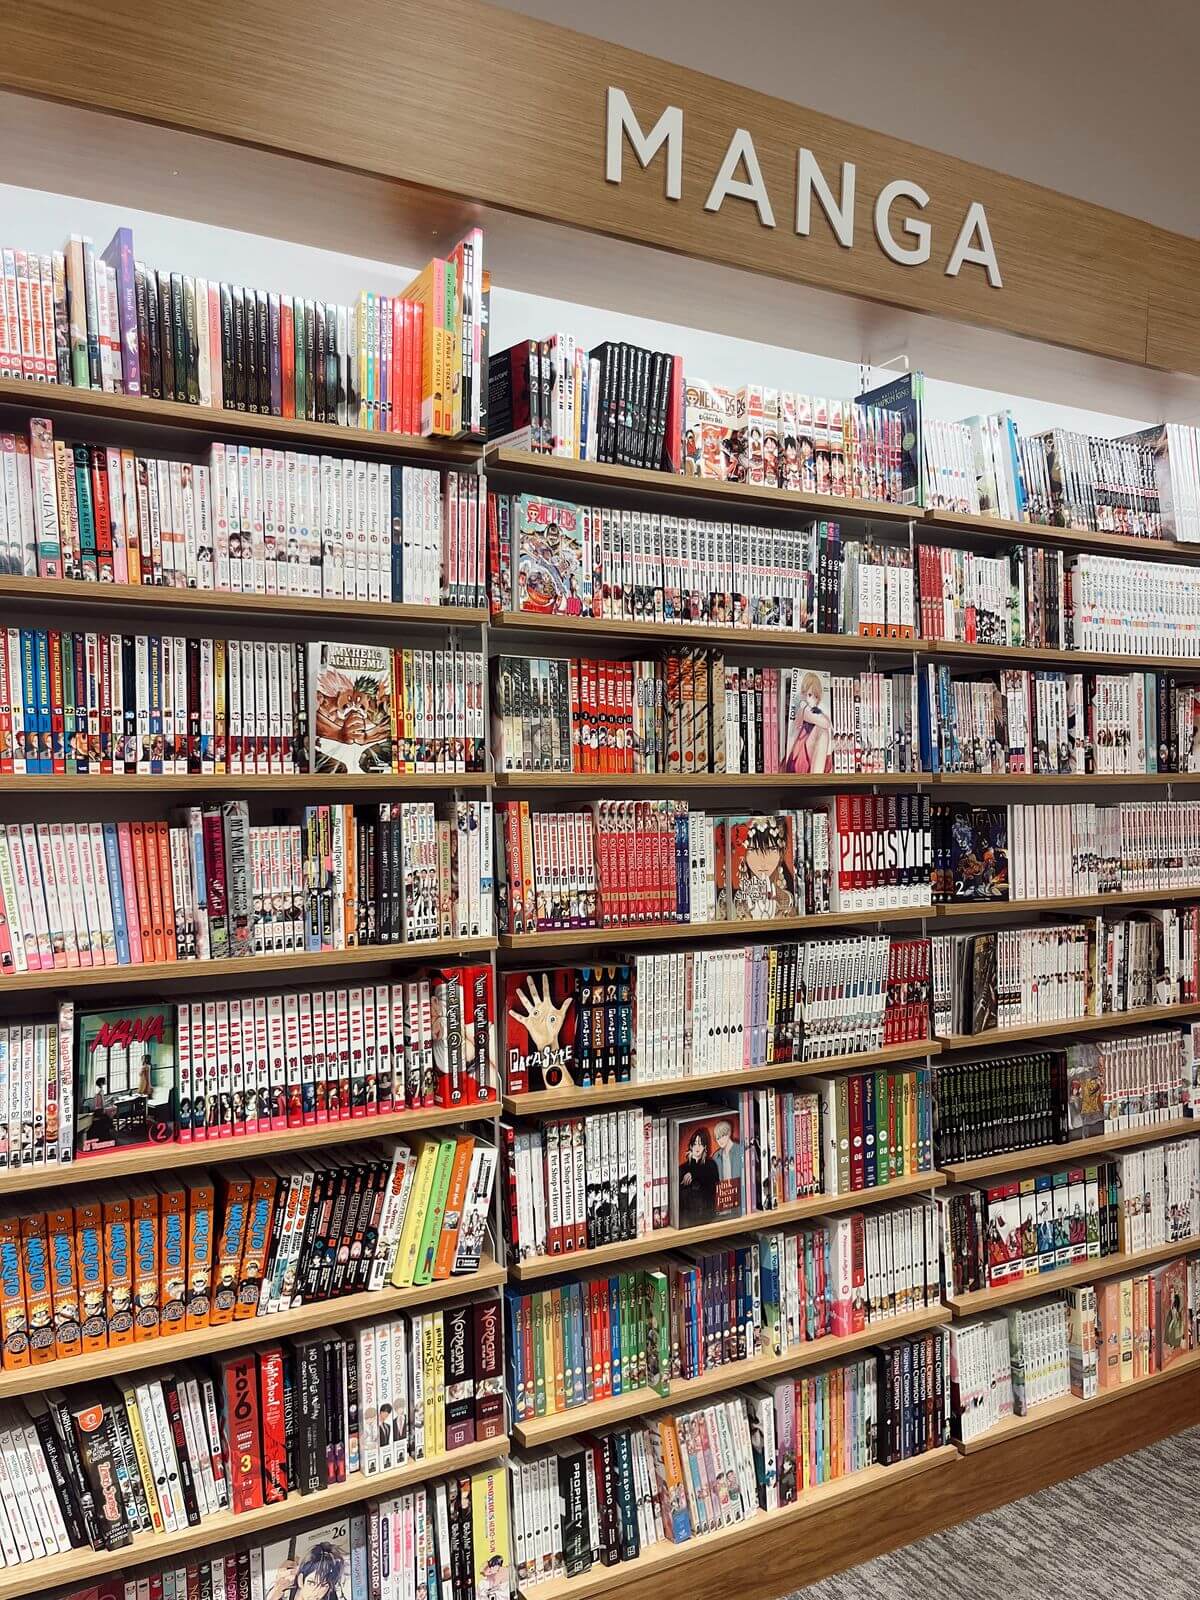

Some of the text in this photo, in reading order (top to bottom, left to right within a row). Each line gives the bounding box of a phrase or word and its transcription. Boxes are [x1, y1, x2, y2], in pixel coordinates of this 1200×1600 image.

[606, 86, 1003, 289] MANGA
[152, 388, 160, 397] 3
[530, 382, 538, 393] 2
[543, 384, 550, 395] 2
[177, 391, 185, 400] 5
[189, 394, 196, 403] 8
[333, 647, 382, 658] MY HERO
[328, 655, 387, 670] ACADEMIA
[76, 707, 87, 716] 26
[102, 708, 111, 716] 28
[230, 819, 243, 834] MY
[232, 836, 244, 863] NAME
[840, 829, 931, 872] PARASYTE
[537, 866, 541, 876] 1
[544, 867, 550, 876] 2
[561, 867, 566, 877] 4
[587, 866, 592, 875] 7
[955, 881, 965, 896] 2
[313, 926, 318, 934] 1
[324, 926, 330, 934] 2
[89, 1014, 165, 1052] NANA
[451, 1035, 457, 1045] 2
[478, 1034, 485, 1045] 3
[246, 1060, 253, 1071] 7
[274, 1057, 281, 1068] 9
[289, 1056, 298, 1068] 11
[209, 1065, 216, 1077] 4
[156, 1123, 166, 1140] 2
[841, 1155, 849, 1164] 05
[392, 1162, 405, 1195] NARUTO
[603, 1169, 608, 1177] 8
[551, 1190, 560, 1222] Horrors
[226, 1203, 245, 1254] NARUTO
[252, 1199, 268, 1249] NARUTO
[165, 1214, 181, 1266] NARUTO
[194, 1209, 210, 1261] NARUTO
[110, 1223, 128, 1276] NARUTO
[140, 1219, 155, 1272] NARUTO
[53, 1233, 73, 1286] NARUTO
[82, 1228, 100, 1281] NARUTO
[1, 1242, 20, 1296] NARUTO
[26, 1237, 45, 1291] NARUTO
[450, 1309, 466, 1376] NORAGAMI
[481, 1306, 497, 1371] NORAGAMI
[284, 1388, 293, 1435] HEROINE
[240, 1455, 251, 1472] 3
[574, 1463, 582, 1528] PROPHECY
[332, 1524, 346, 1539] 26
